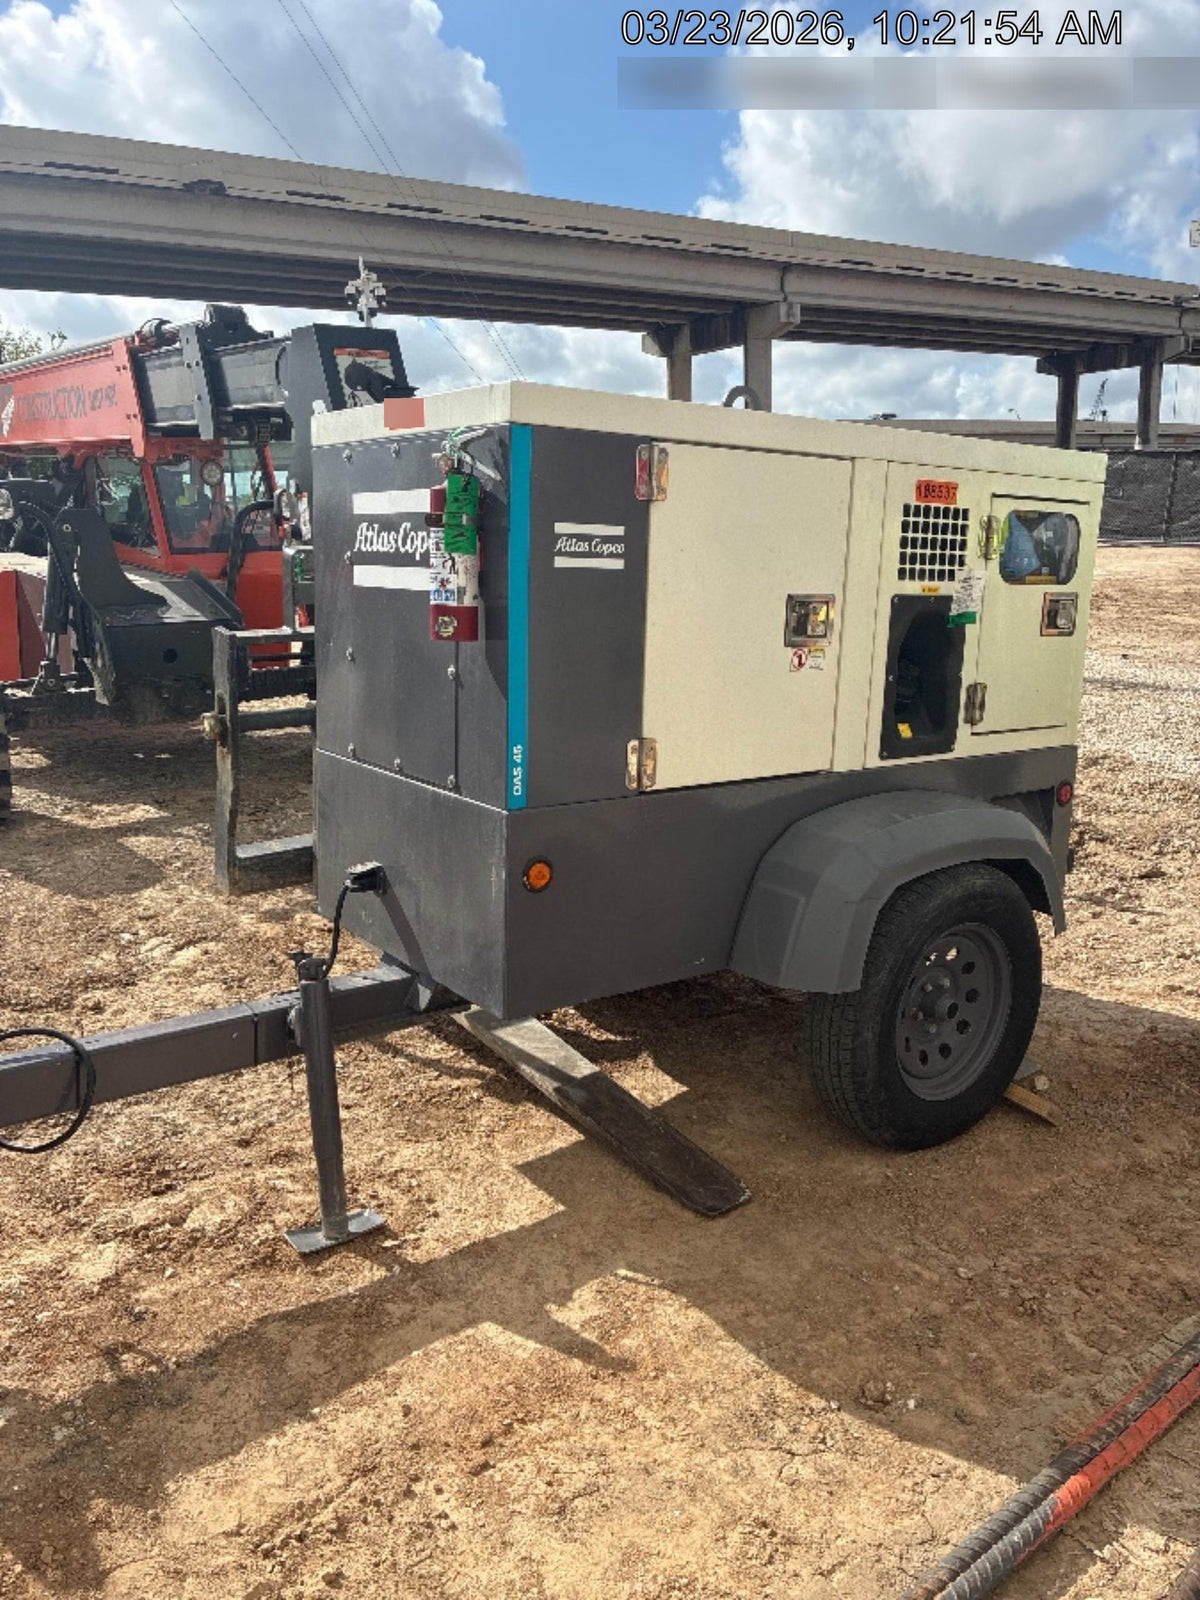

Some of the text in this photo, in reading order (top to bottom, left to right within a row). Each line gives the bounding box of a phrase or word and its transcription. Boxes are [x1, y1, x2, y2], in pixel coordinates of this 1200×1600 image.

[353, 522, 397, 554] Atlas
[397, 522, 430, 561] Cop
[554, 536, 625, 557] Atlas Copco
[512, 744, 523, 764] 45
